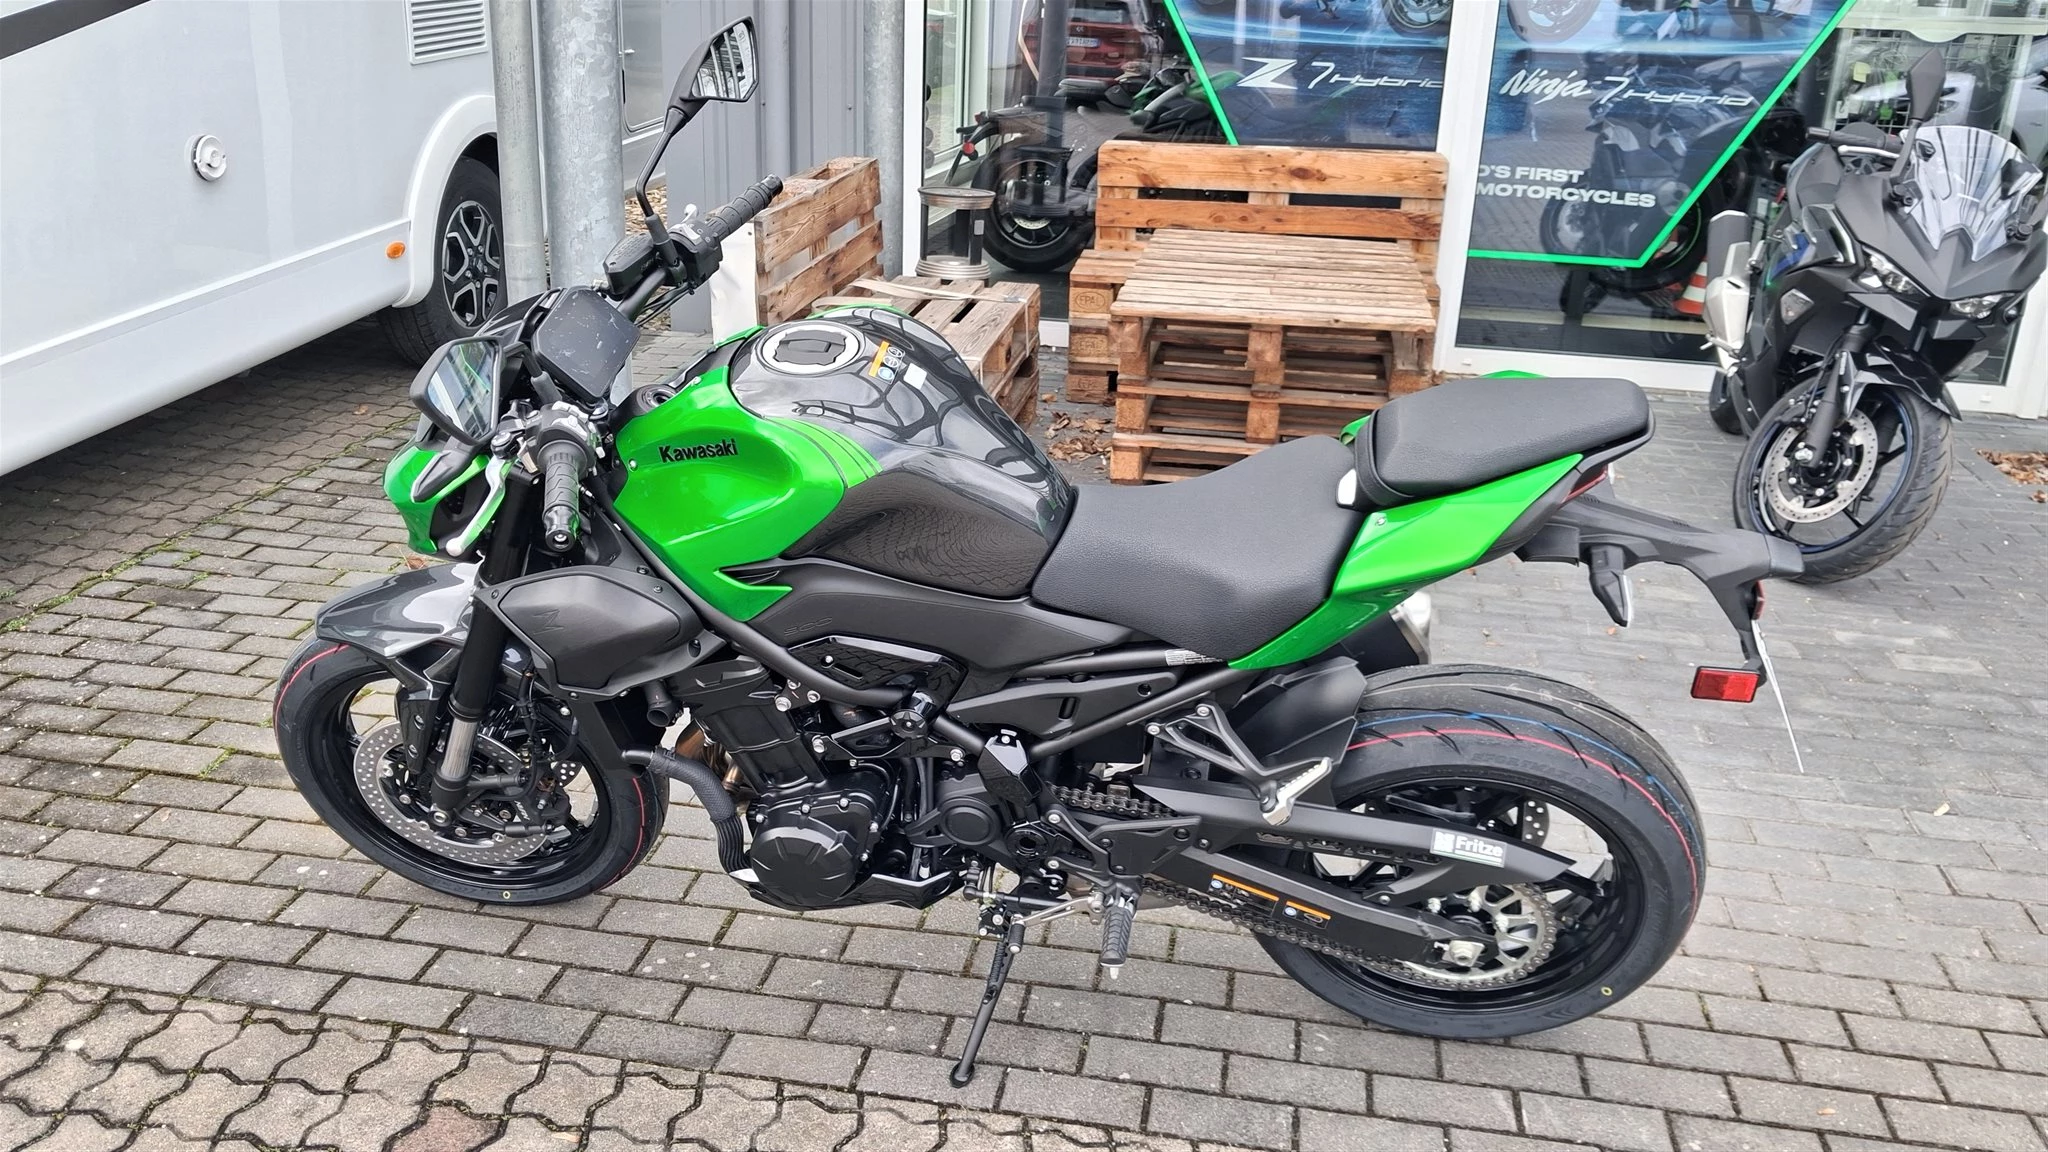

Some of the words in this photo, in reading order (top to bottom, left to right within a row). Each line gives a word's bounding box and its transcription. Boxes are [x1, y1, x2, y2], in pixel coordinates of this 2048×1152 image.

[1308, 61, 1335, 89] 7
[1499, 68, 1591, 105] Ninja
[1600, 76, 1629, 104] 7
[1623, 90, 1754, 107] Hybrid
[1515, 166, 1585, 184] FIRST
[1476, 182, 1656, 208] MOTORCYCLES
[658, 438, 739, 463] Kawasaki
[1456, 835, 1504, 858] Fritze
